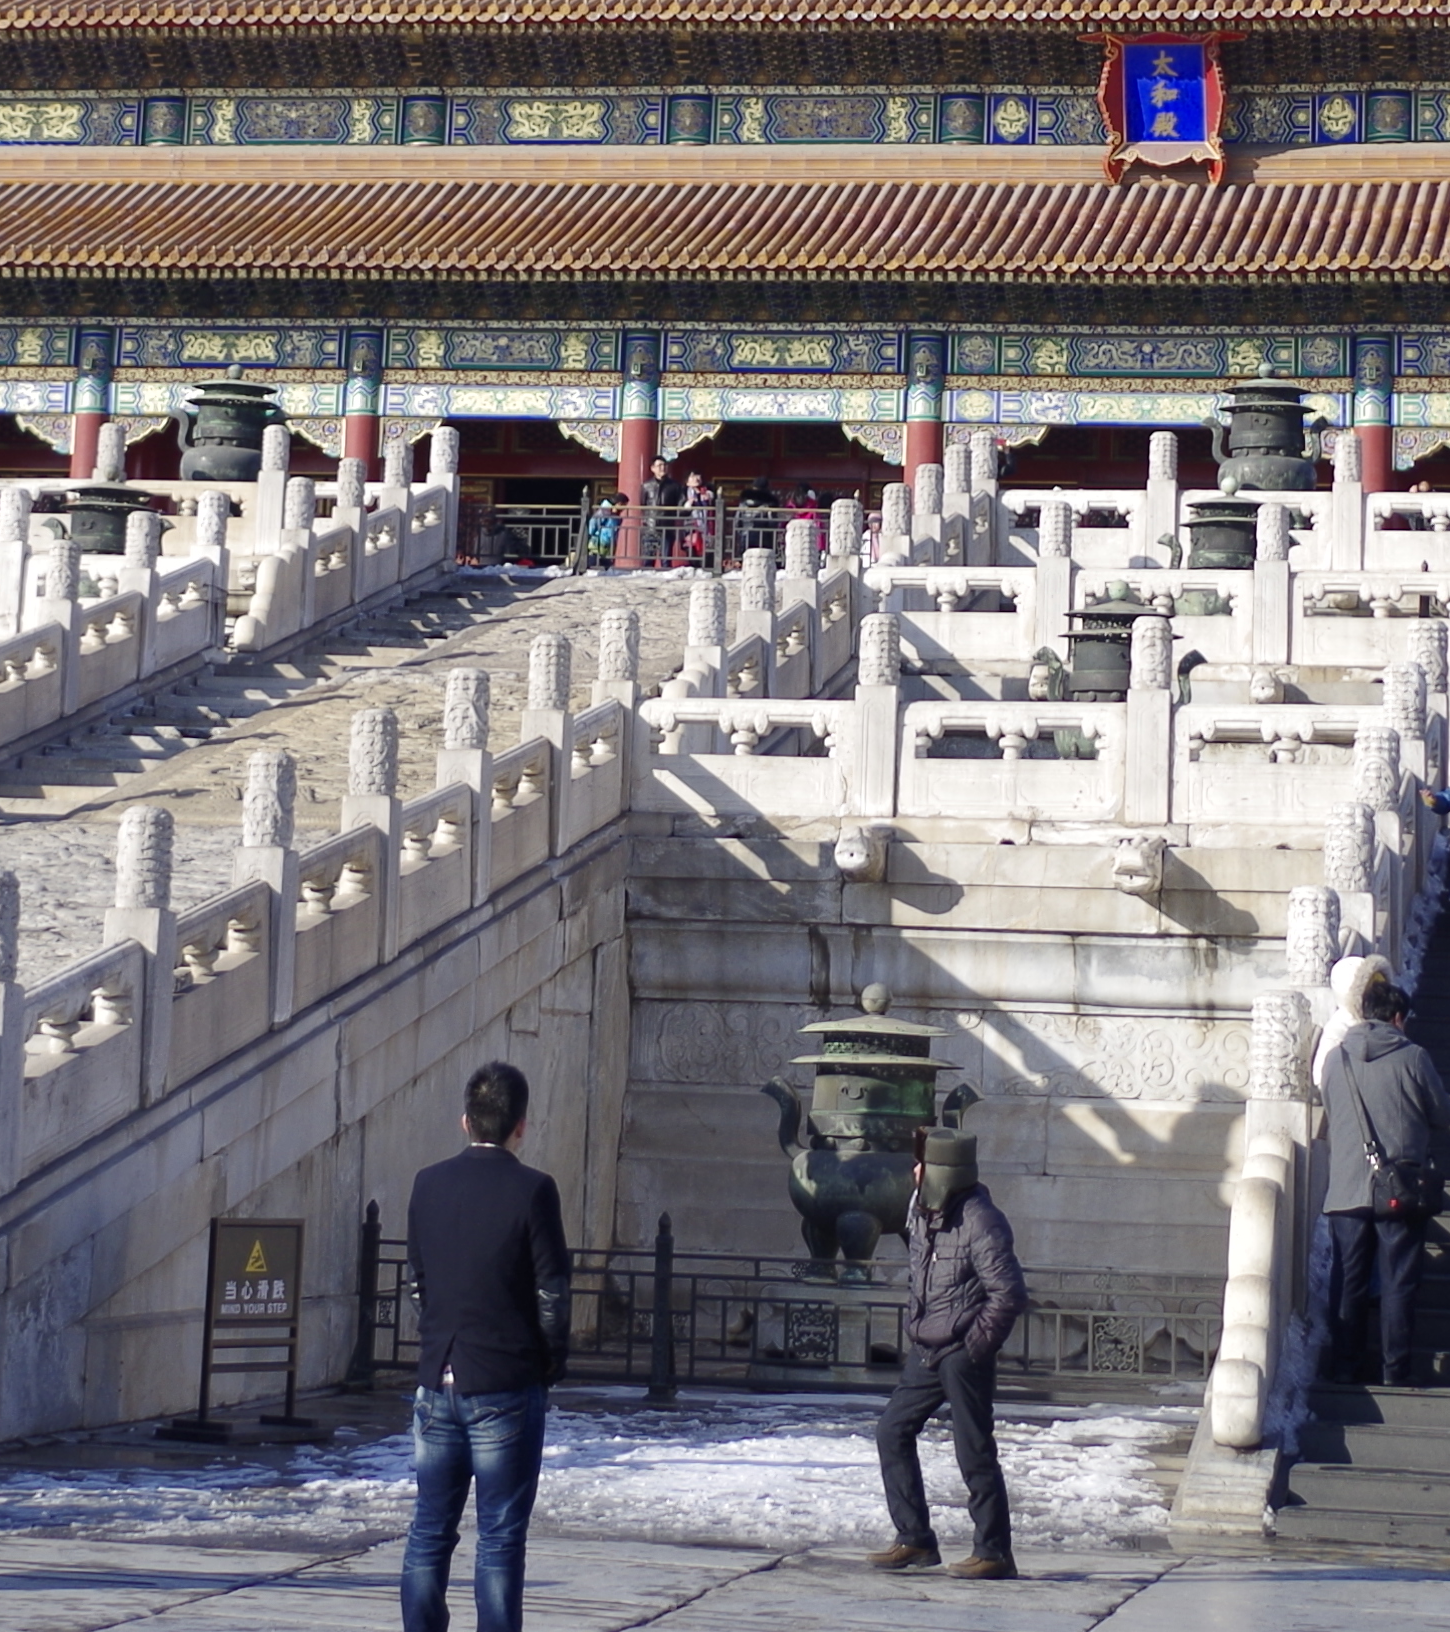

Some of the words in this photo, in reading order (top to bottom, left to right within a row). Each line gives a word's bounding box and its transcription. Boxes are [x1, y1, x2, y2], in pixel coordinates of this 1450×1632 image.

[1149, 49, 1180, 137] 太和殿
[220, 1303, 241, 1315] MIND
[243, 1303, 265, 1315] YOUR
[267, 1302, 288, 1315] STEP
